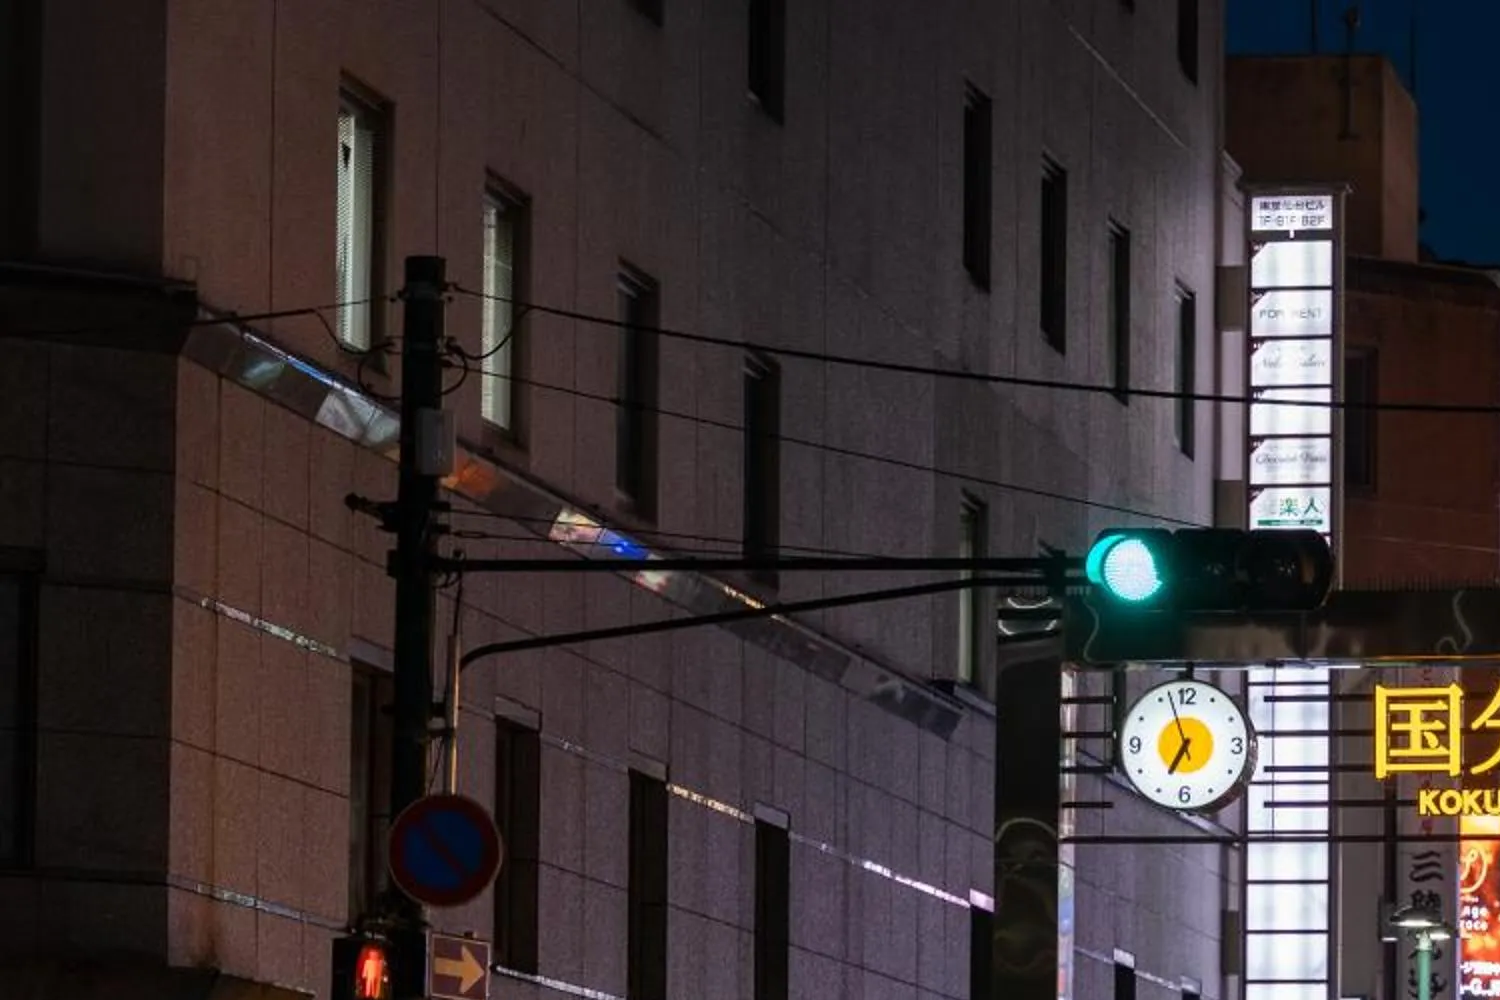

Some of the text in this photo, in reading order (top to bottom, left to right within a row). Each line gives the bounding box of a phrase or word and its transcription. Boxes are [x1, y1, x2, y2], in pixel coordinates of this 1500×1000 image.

[1178, 688, 1197, 705] 12
[1129, 736, 1142, 754] 9
[1231, 737, 1244, 755] 3
[1178, 786, 1191, 803] 6
